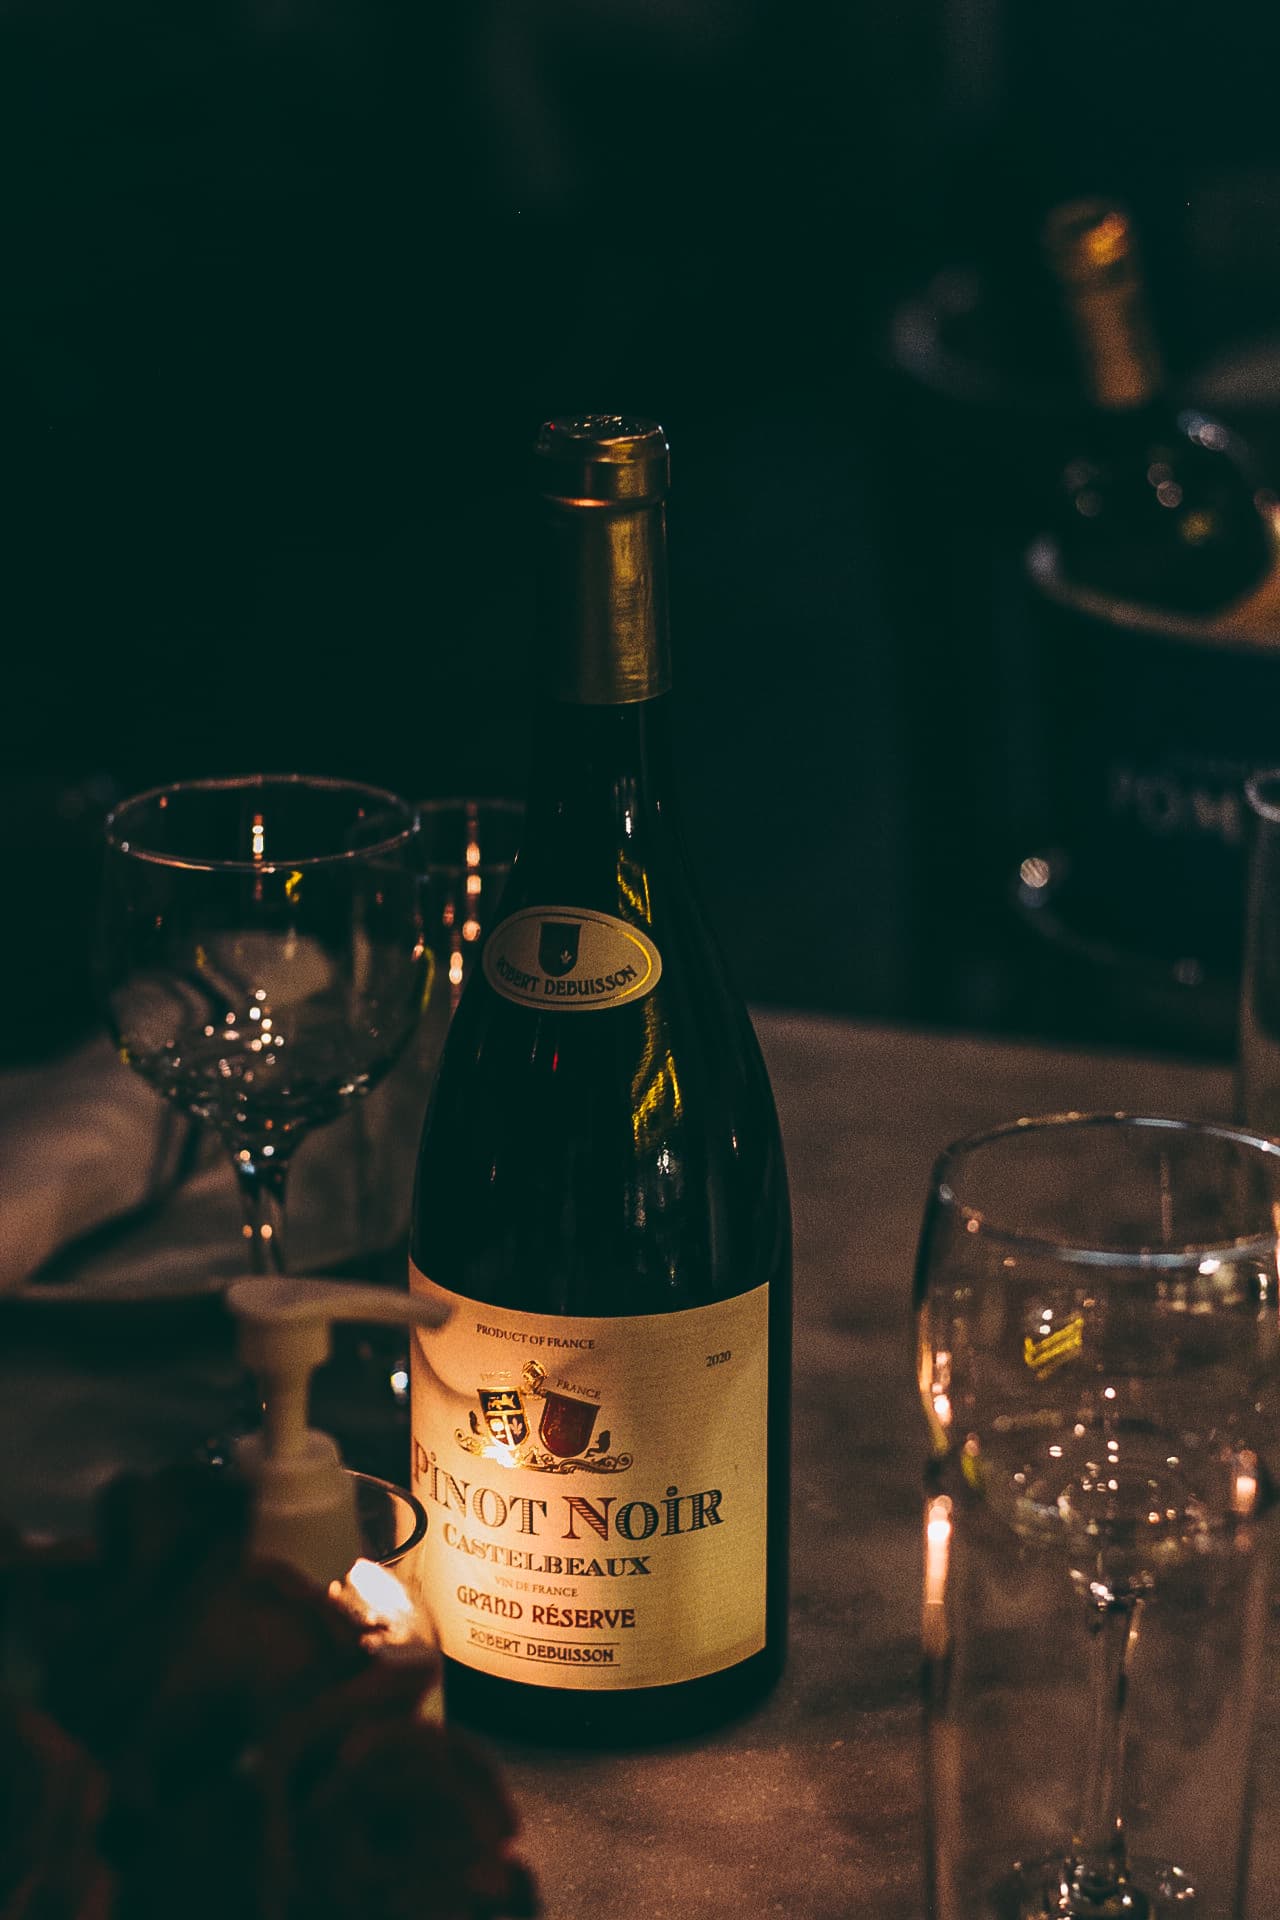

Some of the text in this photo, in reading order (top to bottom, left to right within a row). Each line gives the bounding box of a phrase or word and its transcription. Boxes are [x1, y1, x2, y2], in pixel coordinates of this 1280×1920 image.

[544, 964, 638, 996] DEBUISSON
[476, 1323, 595, 1350] PRODUCT OF FRANCE
[705, 1350, 732, 1368] 2020
[556, 1378, 602, 1400] FRANCE
[443, 1522, 651, 1577] CASTELBEAUX
[495, 1575, 579, 1598] VIN DE FRANCE
[457, 1584, 636, 1629] GRAND RÉSERVE
[470, 1627, 615, 1663] ROBERT DEBUISSON
